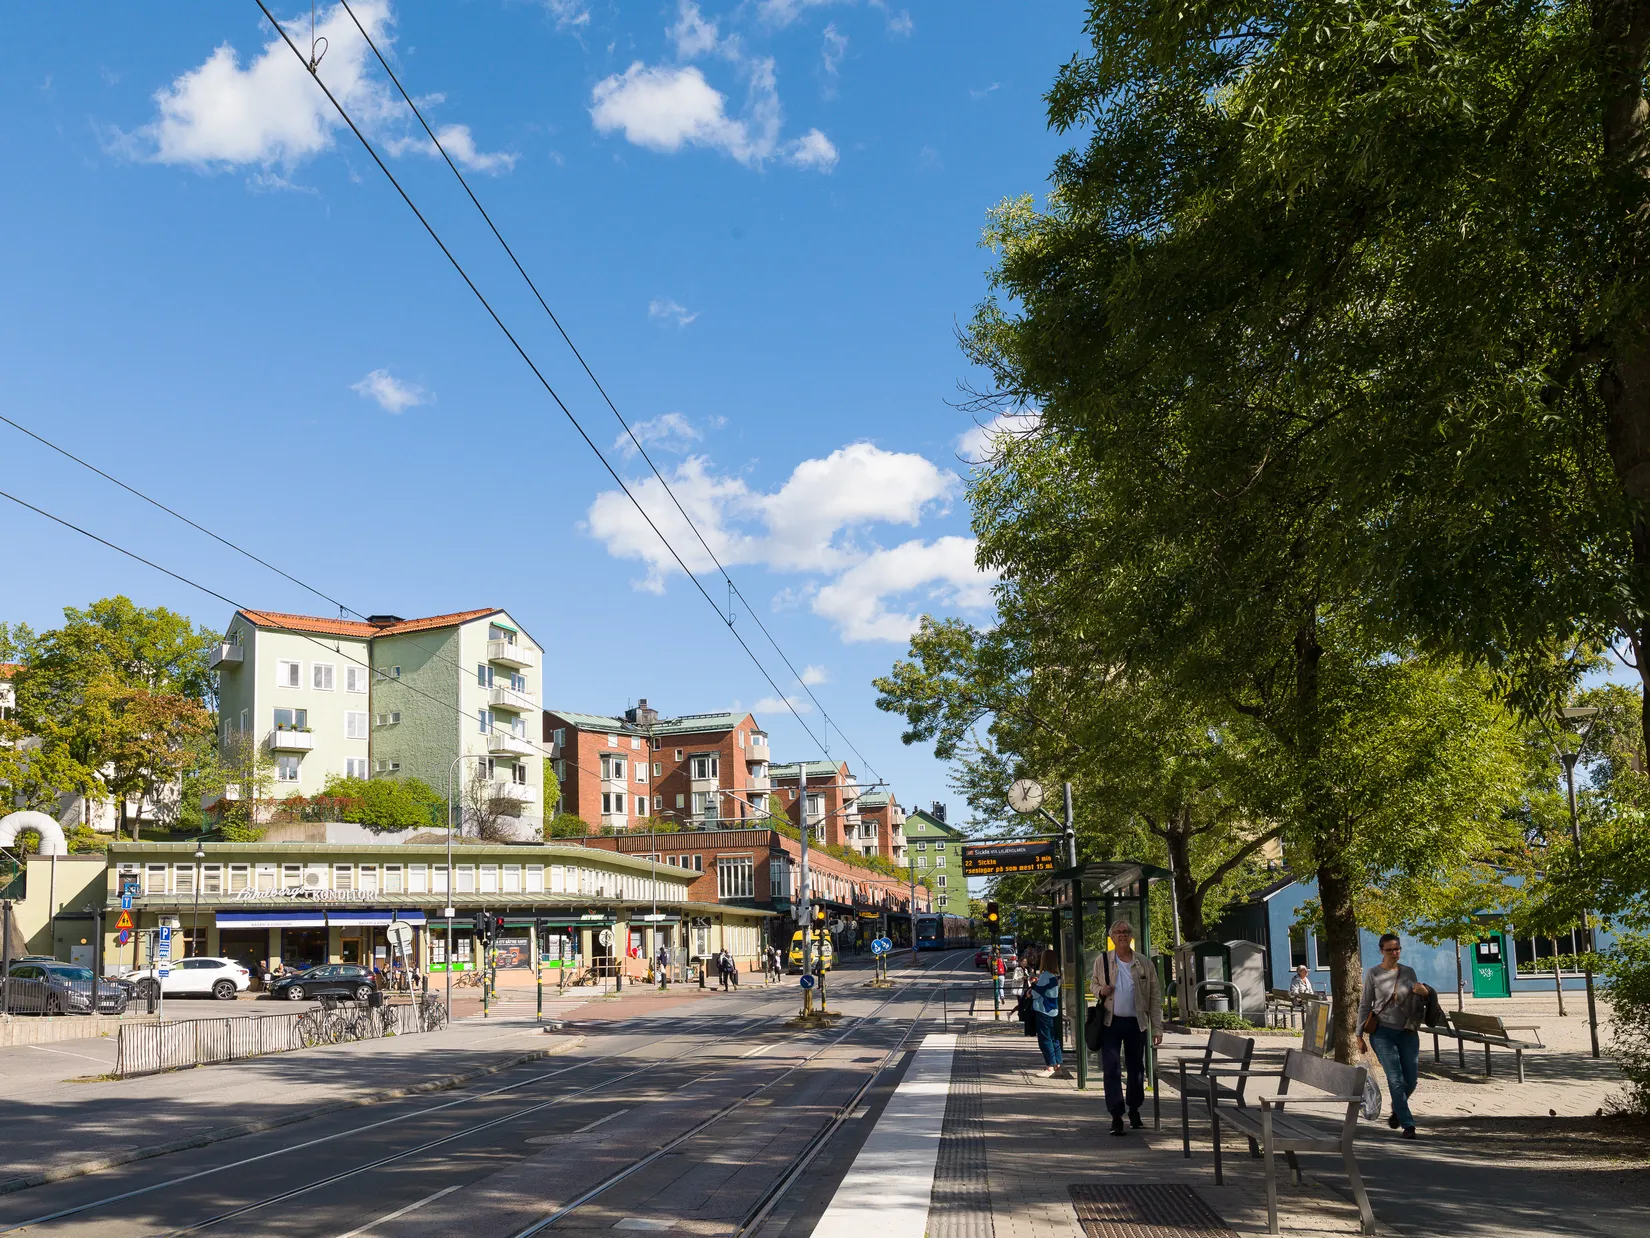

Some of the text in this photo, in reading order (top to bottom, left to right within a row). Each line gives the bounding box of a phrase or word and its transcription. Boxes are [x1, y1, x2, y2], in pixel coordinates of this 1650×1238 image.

[995, 865, 1003, 873] på
[313, 889, 378, 901] KONDITORI
[162, 927, 169, 940] P
